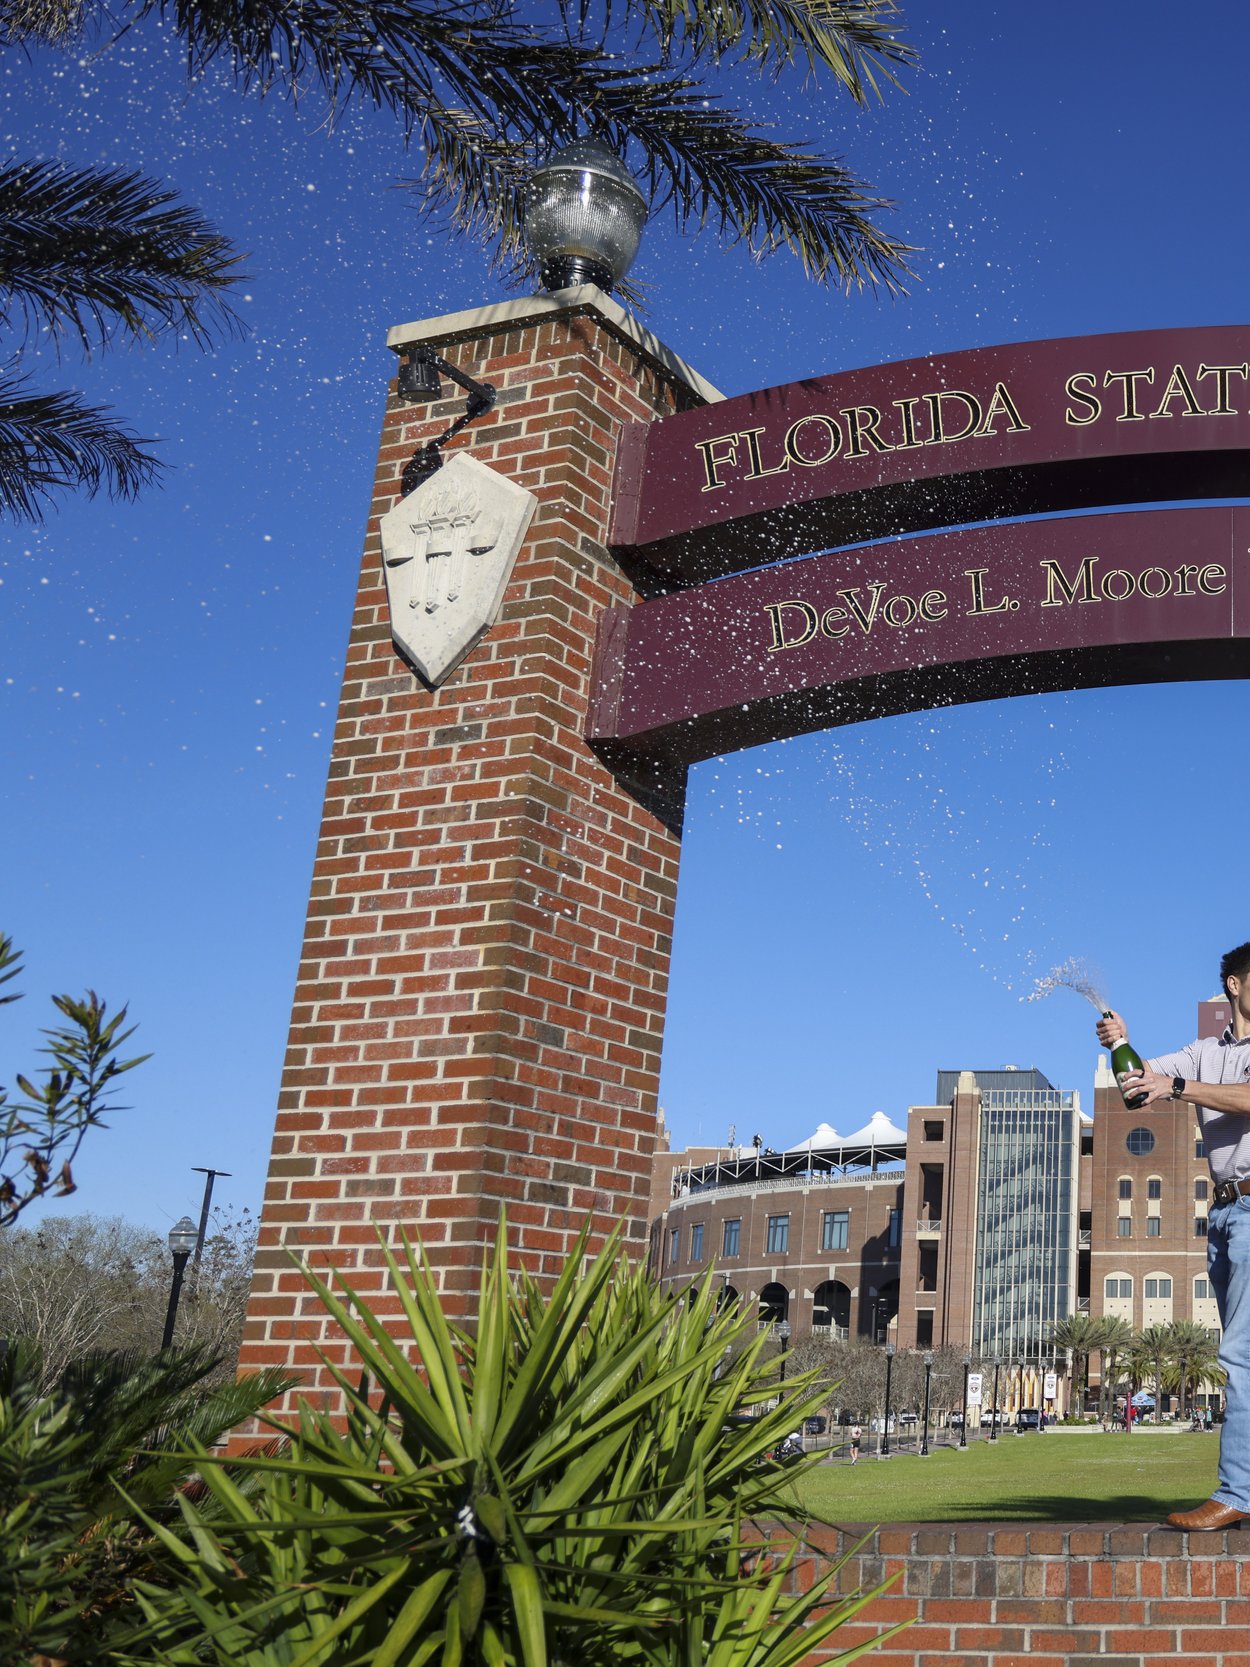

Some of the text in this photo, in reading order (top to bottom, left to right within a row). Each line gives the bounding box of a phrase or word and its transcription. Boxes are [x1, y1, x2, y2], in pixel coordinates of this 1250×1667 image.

[695, 382, 1030, 492] FLORIDA
[765, 582, 948, 652] DeVoe
[964, 568, 1021, 616] L.
[1040, 557, 1227, 607] Moore
